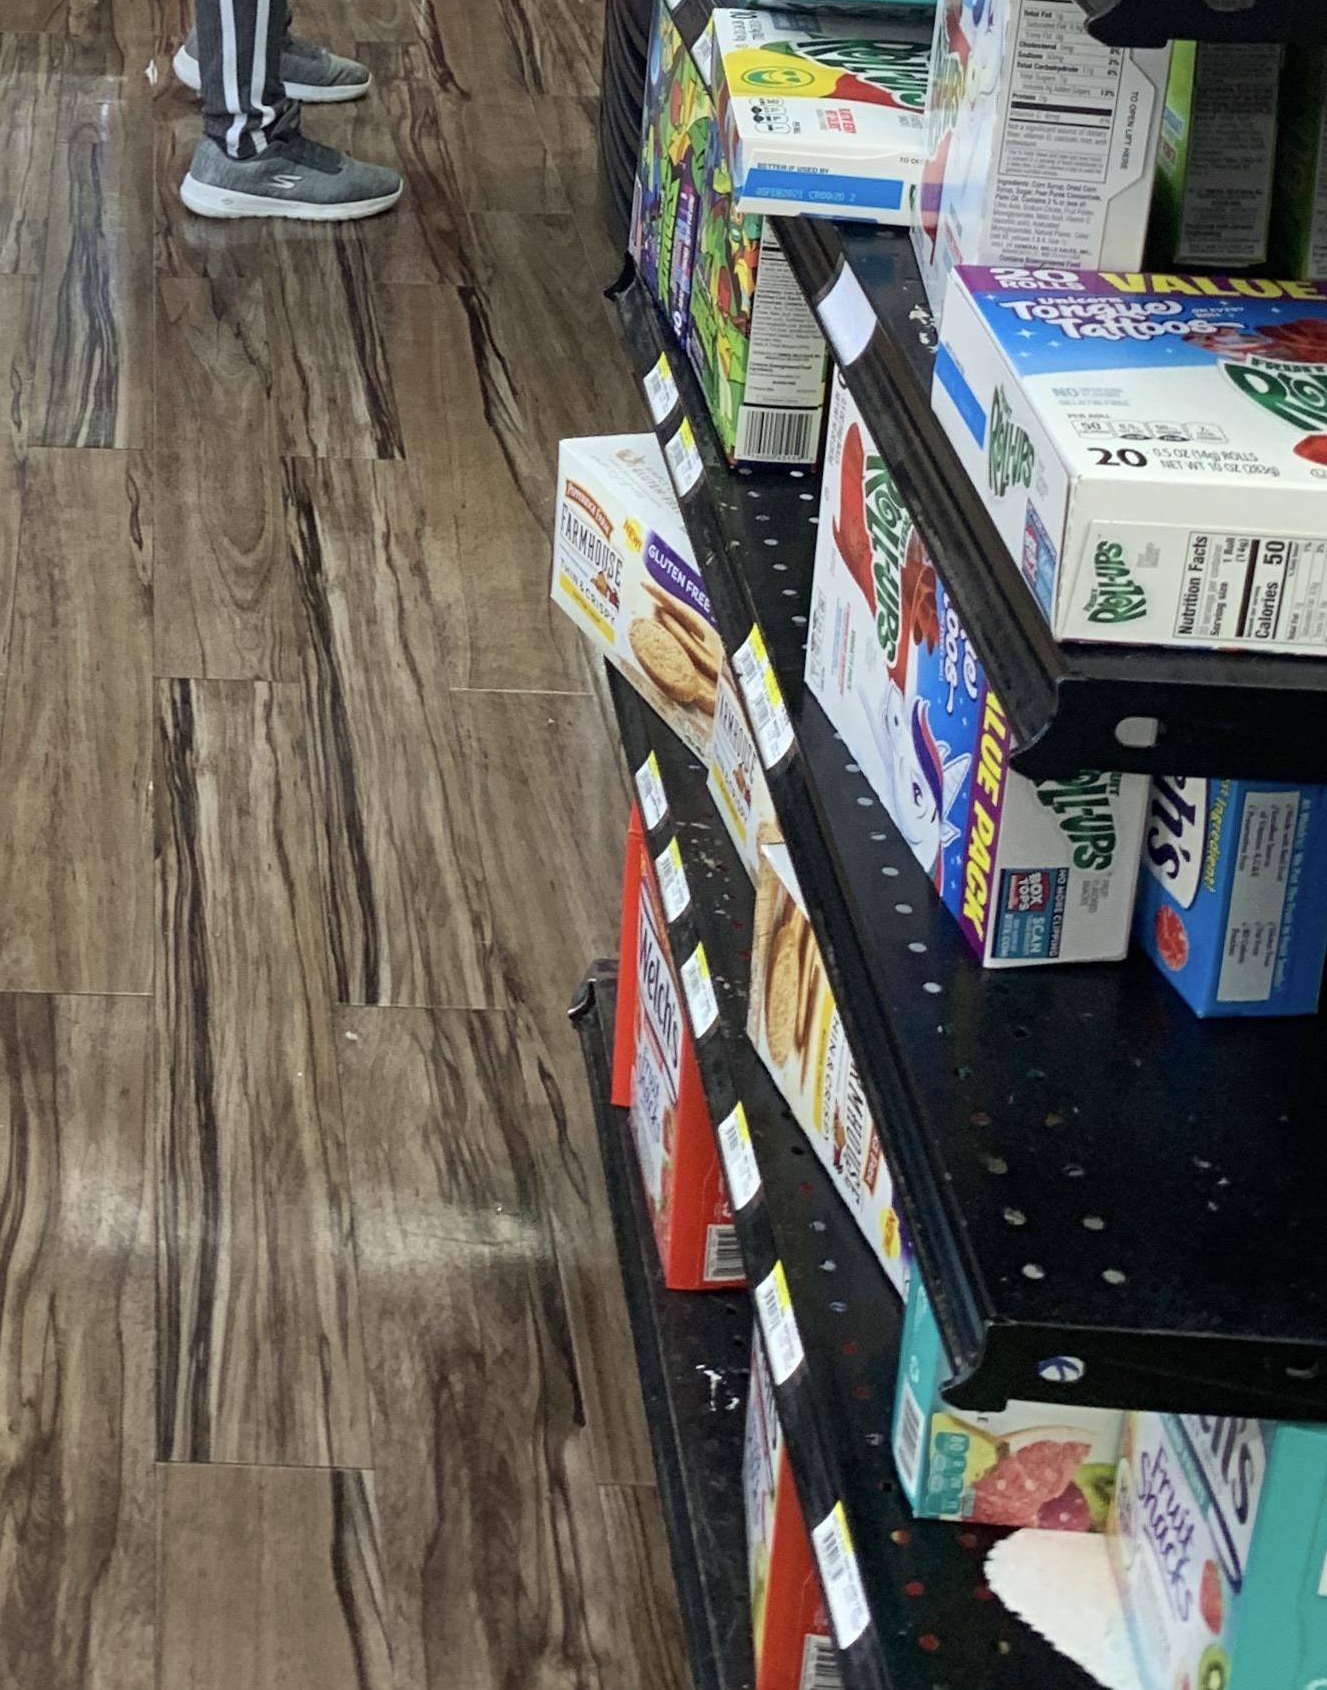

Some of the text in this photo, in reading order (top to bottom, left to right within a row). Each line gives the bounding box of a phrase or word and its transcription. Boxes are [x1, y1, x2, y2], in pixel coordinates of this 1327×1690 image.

[1018, 41, 1057, 51] Cholesterol
[1018, 52, 1043, 60] Sodium
[1016, 62, 1079, 74] Total Carbohydrate
[1011, 93, 1037, 101] Protein
[1129, 91, 1140, 103] TO
[1126, 103, 1138, 131] OPEN
[757, 162, 788, 171] BETTER
[797, 165, 818, 173] USED
[989, 267, 1080, 282] 20
[1000, 279, 1086, 291] ROLLS
[1098, 272, 1327, 301] VALUE
[999, 299, 1183, 324] Tongue
[1038, 295, 1123, 306] Unicorn
[1047, 314, 1246, 341] Tattoos
[1052, 387, 1079, 398] NO
[1081, 421, 1103, 430] 50
[1087, 447, 1148, 468] 20
[1152, 447, 1170, 459] 0.5
[1172, 449, 1189, 460] OZ
[1221, 450, 1259, 463] ROLLS
[1161, 460, 1183, 470] NET
[1185, 461, 1205, 471] WT
[1223, 462, 1241, 473] OZ
[560, 502, 624, 588] FARMHOUSE
[623, 517, 642, 554] NEW!
[647, 543, 711, 614] GLUTEN FREE
[1087, 540, 1148, 624] ROLL-UPS
[1178, 536, 1209, 635] Nutrition Facts
[1210, 537, 1236, 637] Serving size Roll
[1255, 540, 1286, 639] Calories 50
[584, 587, 615, 627] CRISPY
[963, 799, 996, 944] PACK
[1017, 876, 1033, 912] TOPS
[1027, 871, 1043, 905] BOX
[1048, 868, 1067, 958] NO MORE CLIPPING
[1030, 916, 1046, 954] SCAN
[640, 930, 679, 1069] Welch's
